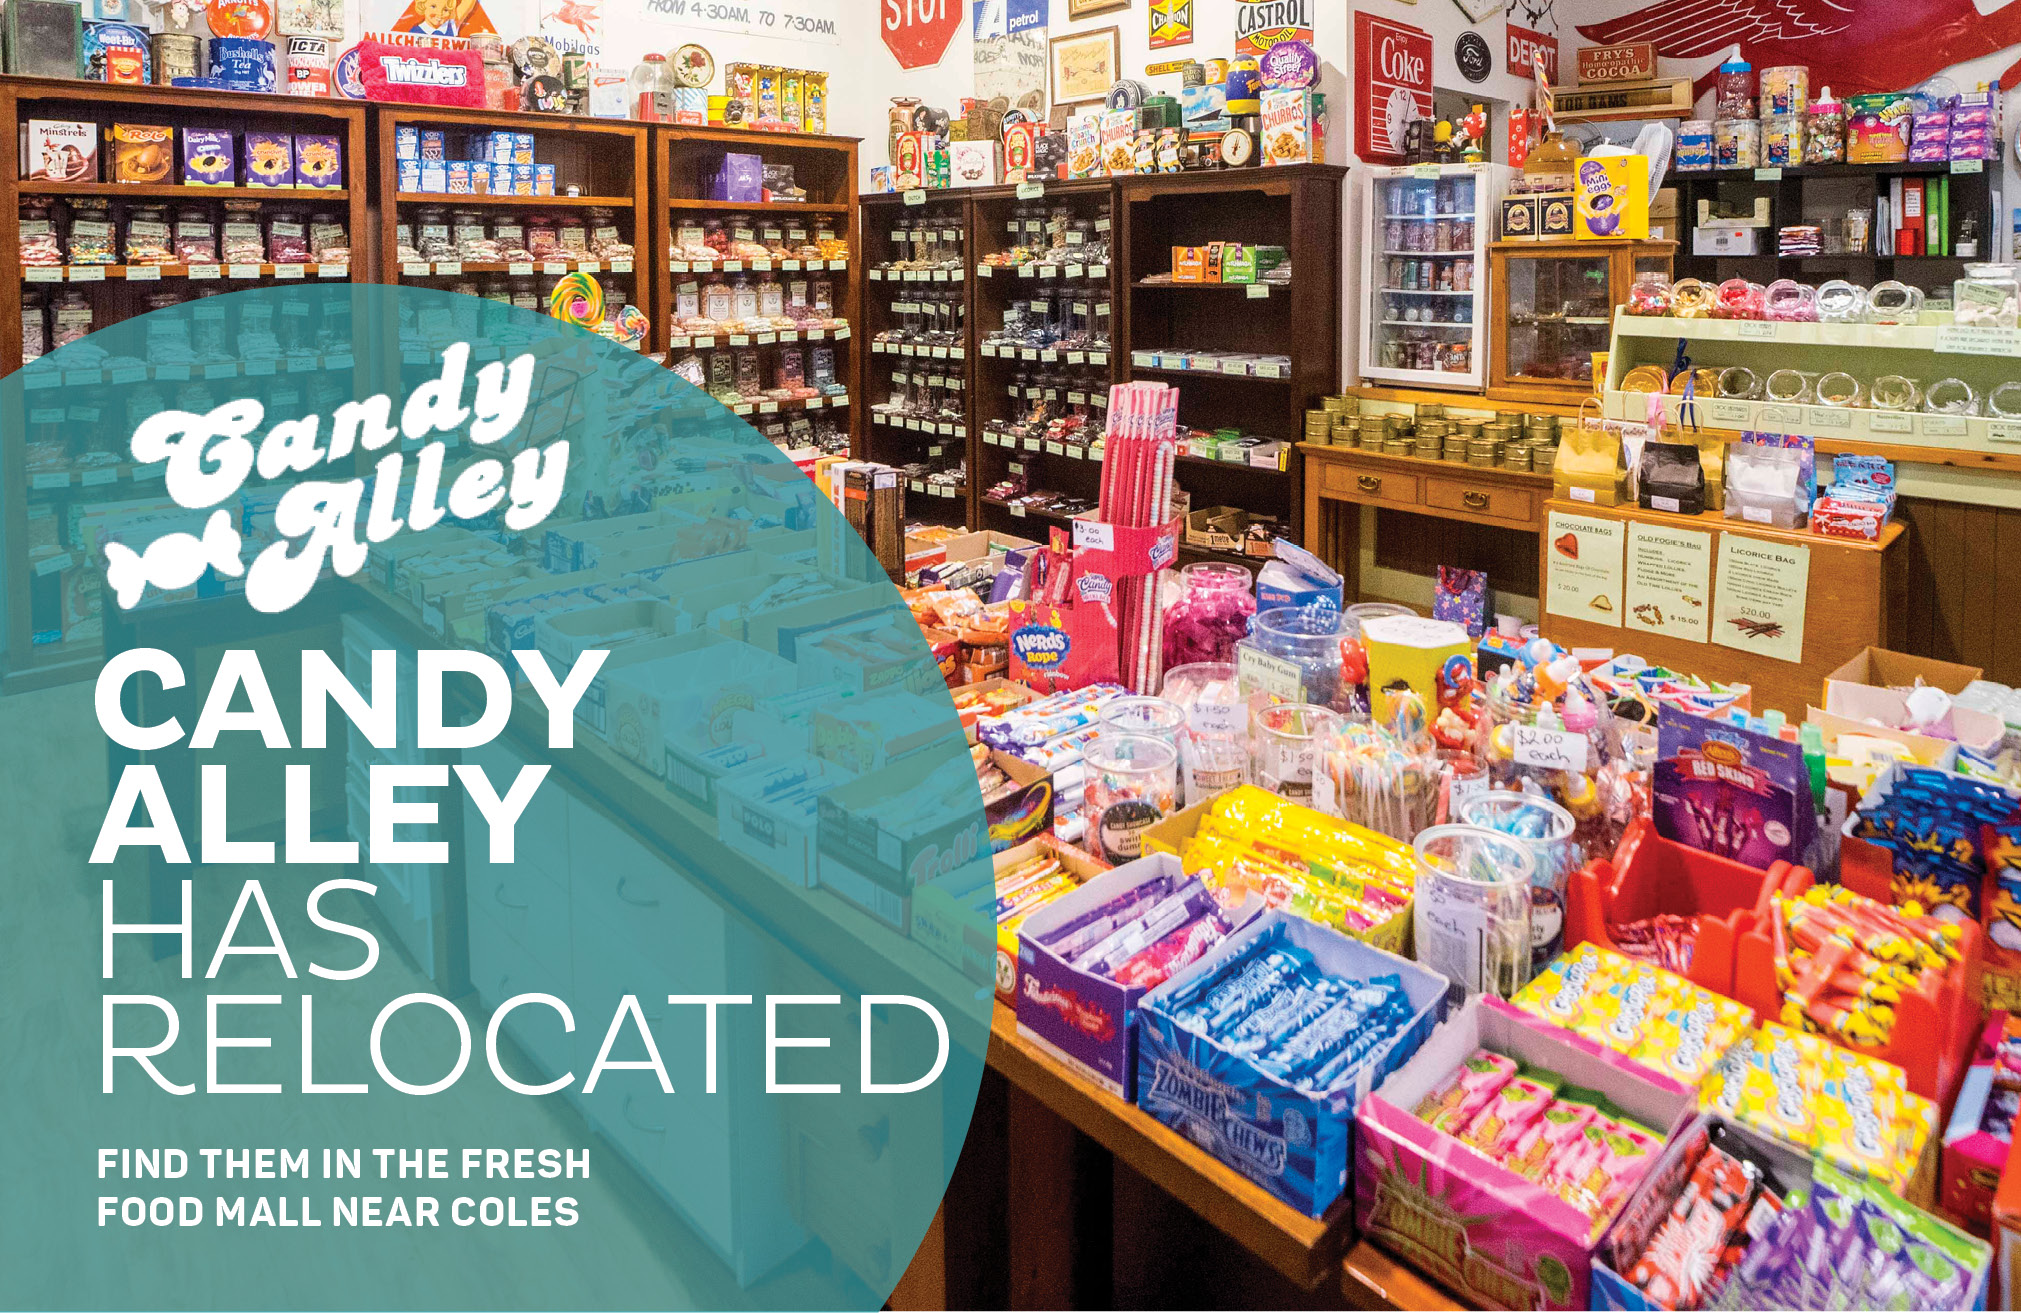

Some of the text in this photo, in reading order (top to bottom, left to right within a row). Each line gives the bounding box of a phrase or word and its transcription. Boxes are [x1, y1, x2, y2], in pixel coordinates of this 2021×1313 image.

[758, 11, 775, 26] TO
[1009, 10, 1039, 31] petrol
[1152, 5, 1189, 30] CHAION
[1238, 0, 1310, 35] CASTROL
[98, 33, 135, 46] Weet-Bix
[1279, 29, 1293, 43] OIL
[1395, 33, 1408, 44] Enjoy
[543, 36, 600, 56] Mobilgas
[219, 46, 264, 63] Bushells
[1269, 51, 1302, 67] Quality
[1381, 36, 1424, 86] Coke
[1510, 35, 1555, 74] DEPOT
[1594, 48, 1635, 61] FRY'S
[232, 59, 251, 70] Tea
[382, 57, 466, 86] Twizzlers
[1149, 64, 1170, 74] SHELL
[1274, 62, 1302, 78] Street
[1587, 65, 1641, 79] COCOA
[297, 69, 310, 79] BP
[1399, 90, 1407, 101] 12
[1262, 104, 1304, 132] CHURROS
[1387, 114, 1392, 124] 9
[39, 127, 87, 137] Minstrels
[130, 130, 166, 143] Rolo
[1101, 122, 1134, 144] CHURROS
[1072, 134, 1096, 148] Crunch
[1586, 173, 1609, 187] Mini
[1587, 181, 1612, 194] eggs
[1555, 521, 1612, 536] CHOCOLATE BAGS
[1086, 536, 1104, 545] each
[1637, 534, 1702, 550] OLD FOGIE'S BAG
[1730, 546, 1796, 565] LICORICE BAG
[1078, 578, 1112, 593] Candy
[1562, 584, 1579, 592] 20.00
[1740, 606, 1771, 619] $20.00
[1677, 616, 1699, 626] 15.00
[1242, 652, 1256, 667] Cry
[1257, 655, 1276, 672] Baby
[1276, 664, 1297, 680] Gum
[1043, 670, 1070, 680] rainbow
[1528, 748, 1571, 764] each
[1297, 766, 1313, 777] ea
[1692, 759, 1755, 790] RED SKINS
[744, 811, 774, 837] POLO
[908, 822, 980, 888] Trolli
